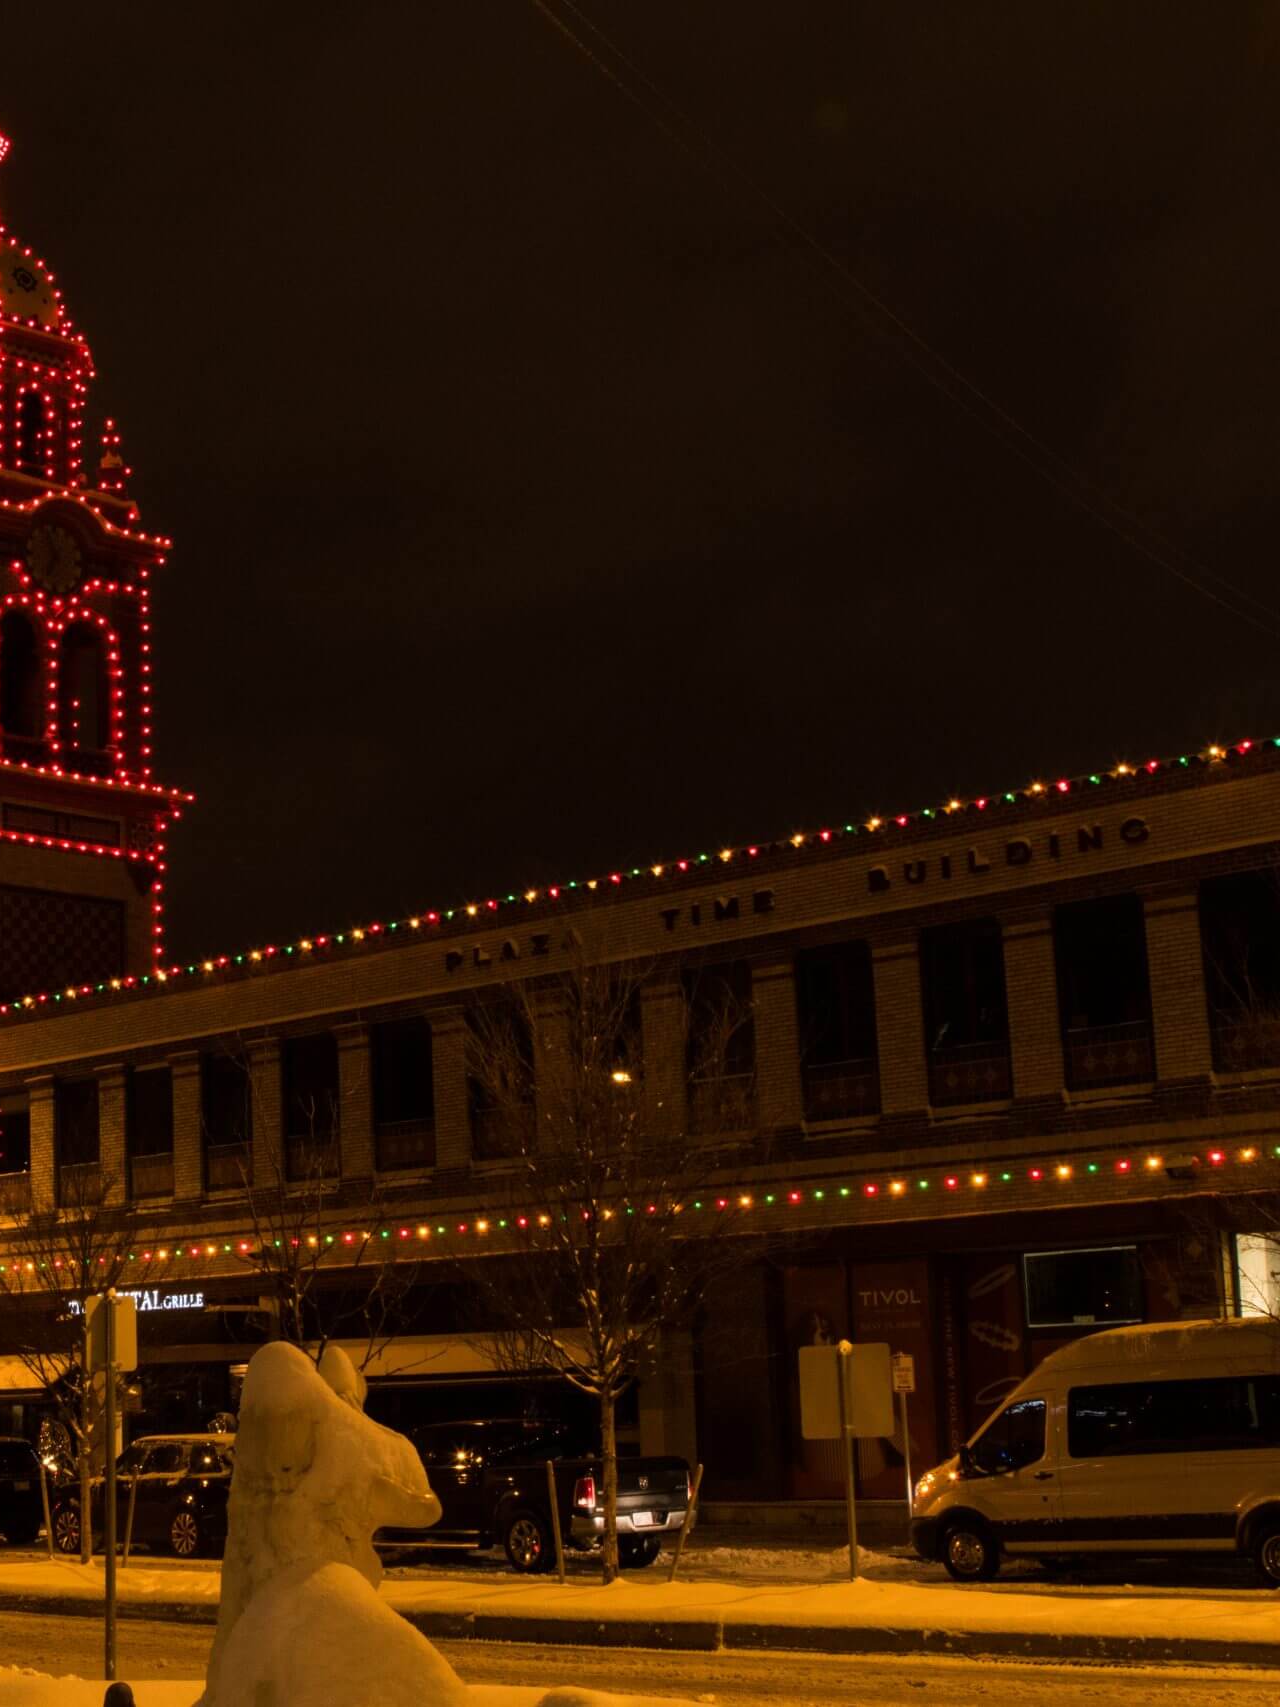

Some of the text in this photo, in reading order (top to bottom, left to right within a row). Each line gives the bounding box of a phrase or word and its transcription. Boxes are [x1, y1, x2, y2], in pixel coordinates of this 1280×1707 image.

[661, 889, 775, 931] TIME
[868, 817, 1149, 892] BUILDING
[163, 1293, 204, 1309] GRILLE
[857, 1288, 922, 1307] TIVOL
